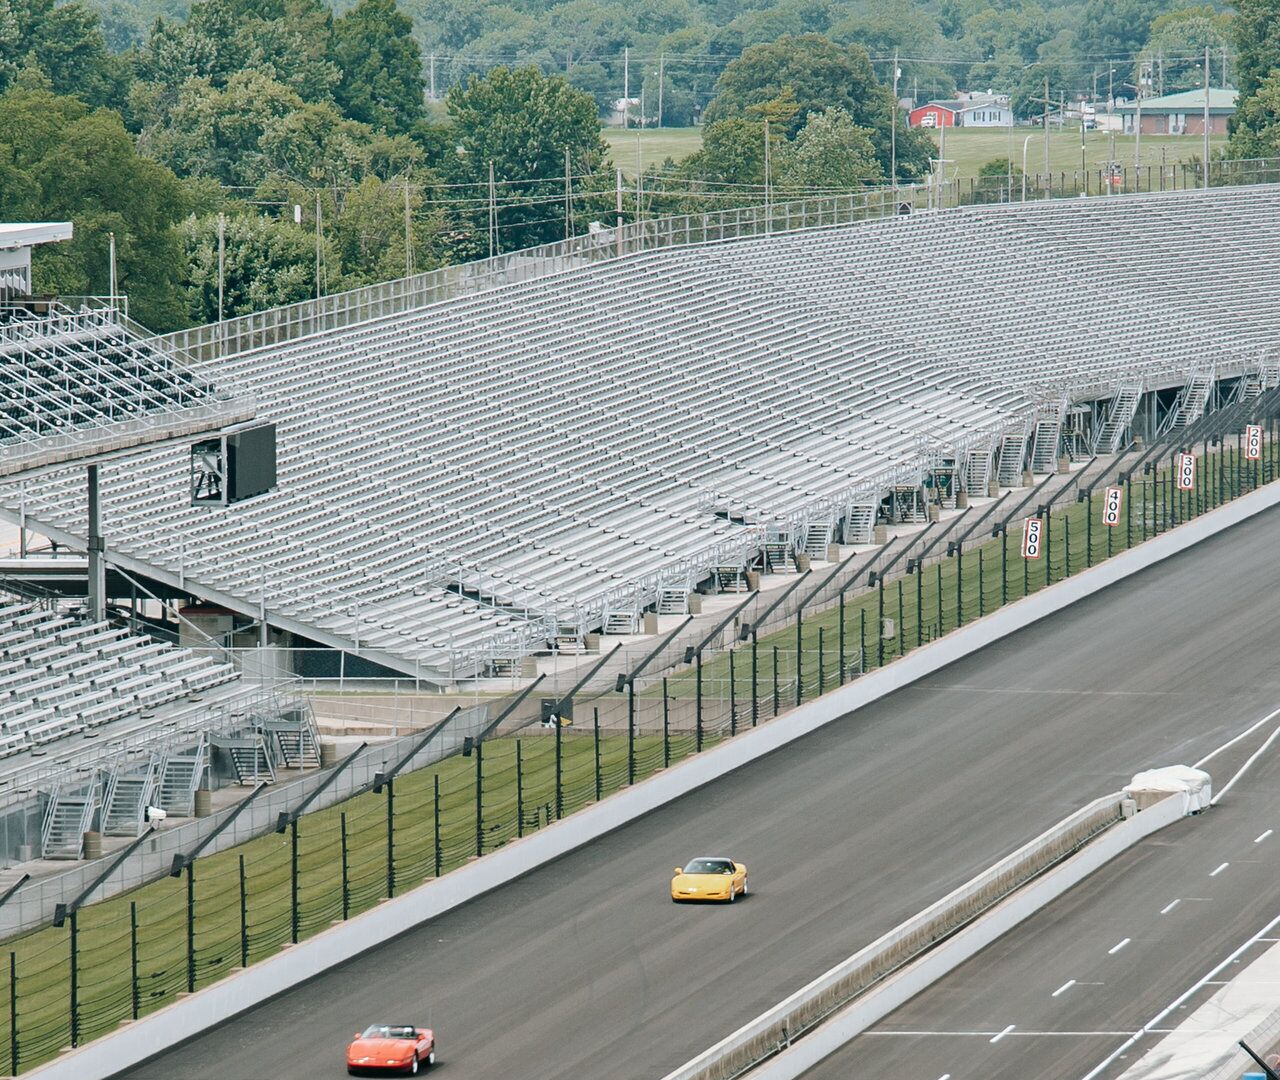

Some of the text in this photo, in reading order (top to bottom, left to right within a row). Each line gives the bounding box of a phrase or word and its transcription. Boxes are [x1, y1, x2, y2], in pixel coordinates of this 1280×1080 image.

[1250, 428, 1259, 456] 200
[1183, 456, 1193, 486] 300
[1108, 491, 1118, 521] 400
[1028, 522, 1038, 555] 500
